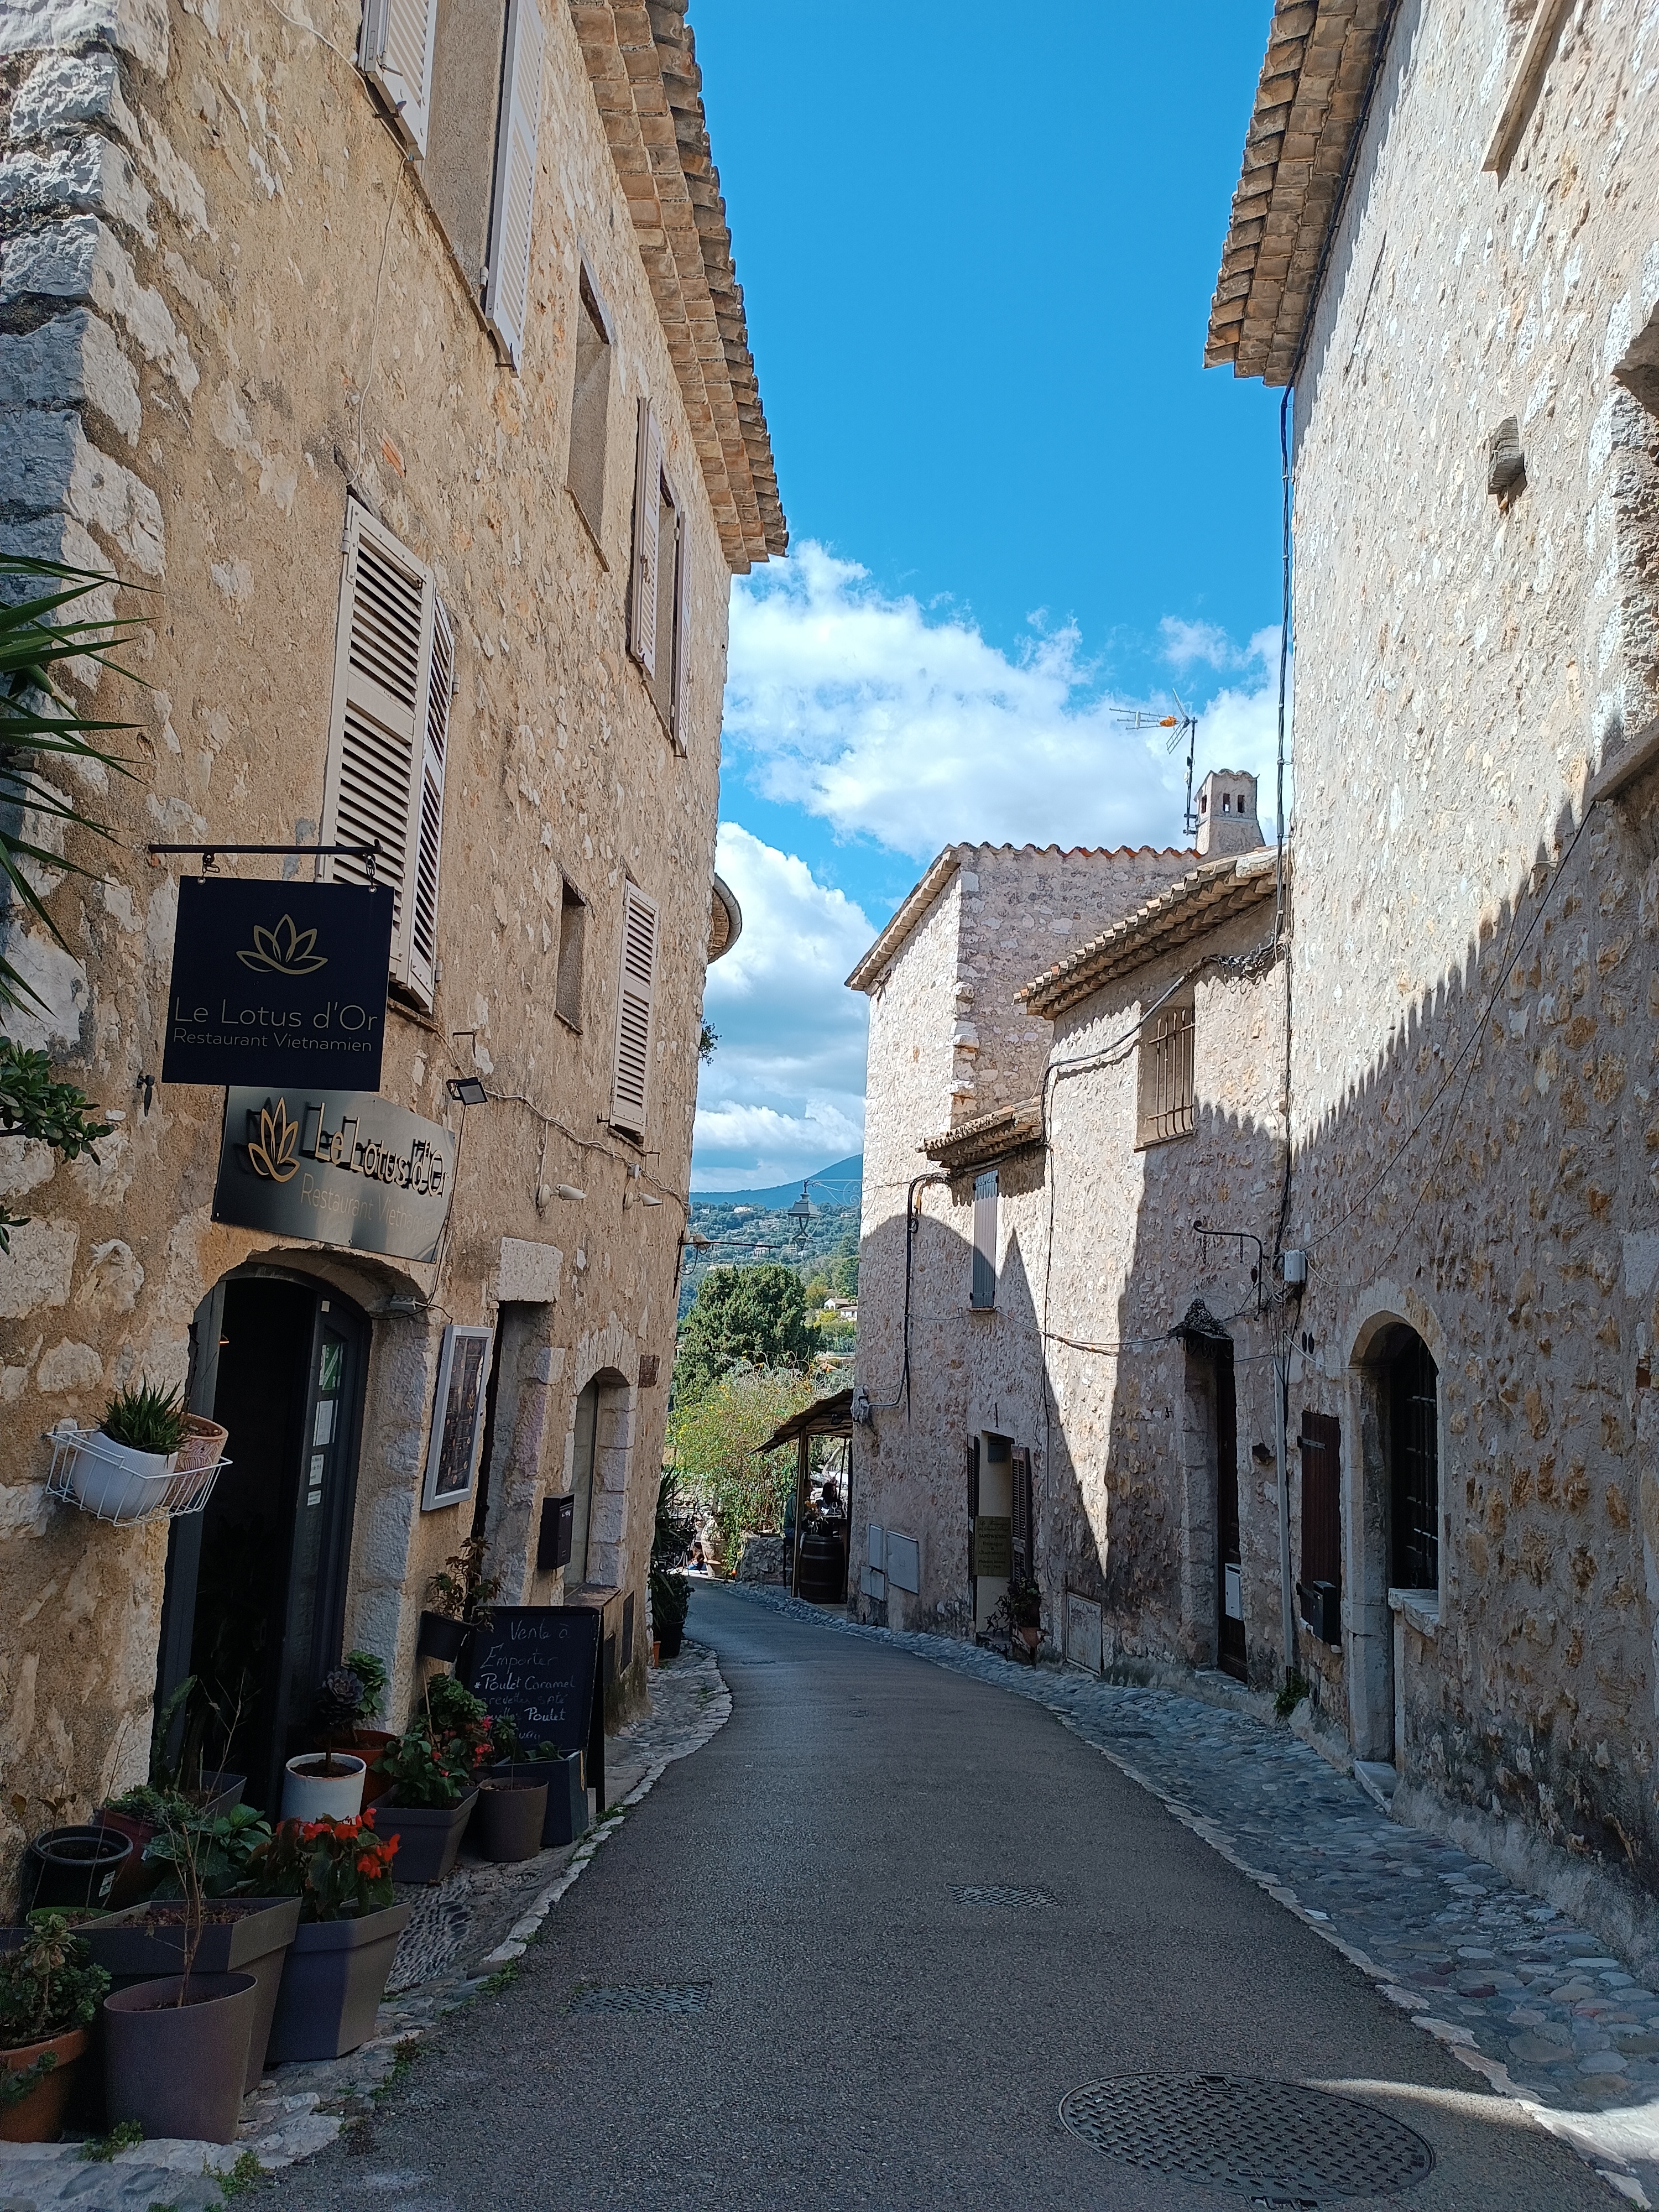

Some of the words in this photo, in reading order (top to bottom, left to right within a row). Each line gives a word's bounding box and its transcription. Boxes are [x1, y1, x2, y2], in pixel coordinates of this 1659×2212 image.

[175, 997, 208, 1023] Le
[222, 999, 301, 1027] Lotus
[314, 1002, 377, 1030] d'Or
[173, 1027, 268, 1047] Restaurant
[274, 1032, 372, 1052] Vietnamien
[315, 1103, 343, 1165] Le
[350, 1117, 405, 1186] Lotus
[411, 1139, 449, 1198] d'Or
[300, 1173, 373, 1220] Restaurant
[379, 1196, 437, 1235] Vietnamien
[510, 1618, 551, 1640] Vente
[479, 1642, 558, 1674] Emporter
[481, 1672, 521, 1690] Poulet
[525, 1675, 576, 1690] Caramel
[524, 1707, 567, 1721] Poulet
